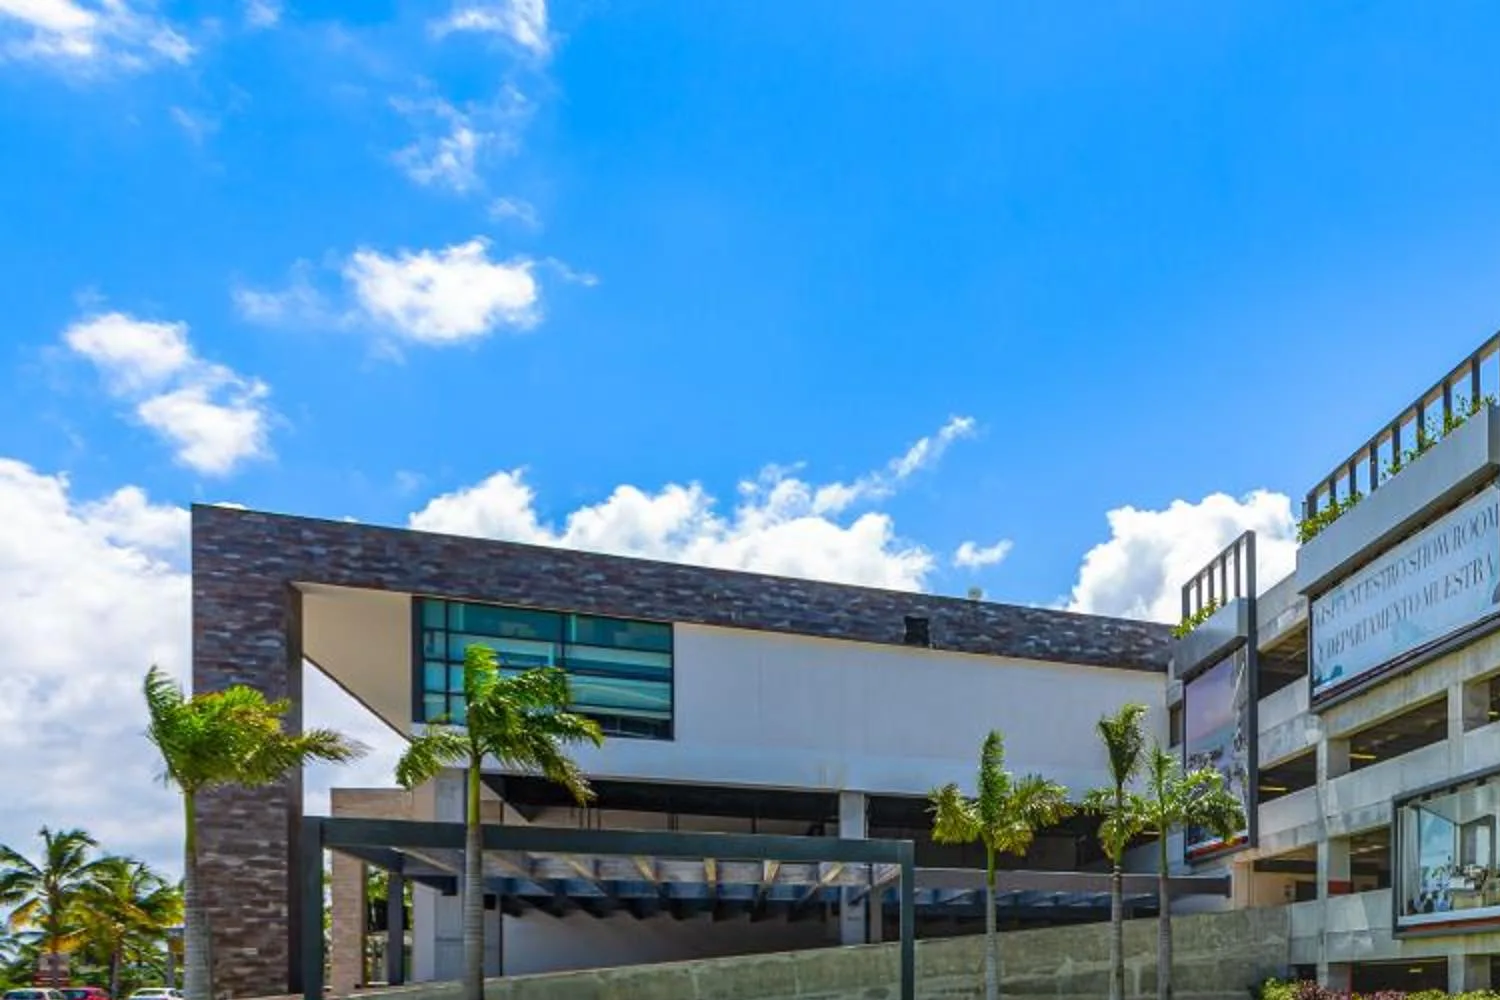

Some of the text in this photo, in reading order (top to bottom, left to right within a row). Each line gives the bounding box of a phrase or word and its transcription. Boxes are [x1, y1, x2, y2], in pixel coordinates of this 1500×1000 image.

[1326, 591, 1421, 660] DEPARTAMENTO
[1423, 552, 1496, 608] MUESTRA
[1350, 556, 1406, 606] NUESTRO
[1409, 532, 1449, 574] SHOW
[1453, 502, 1499, 553] ROOM
